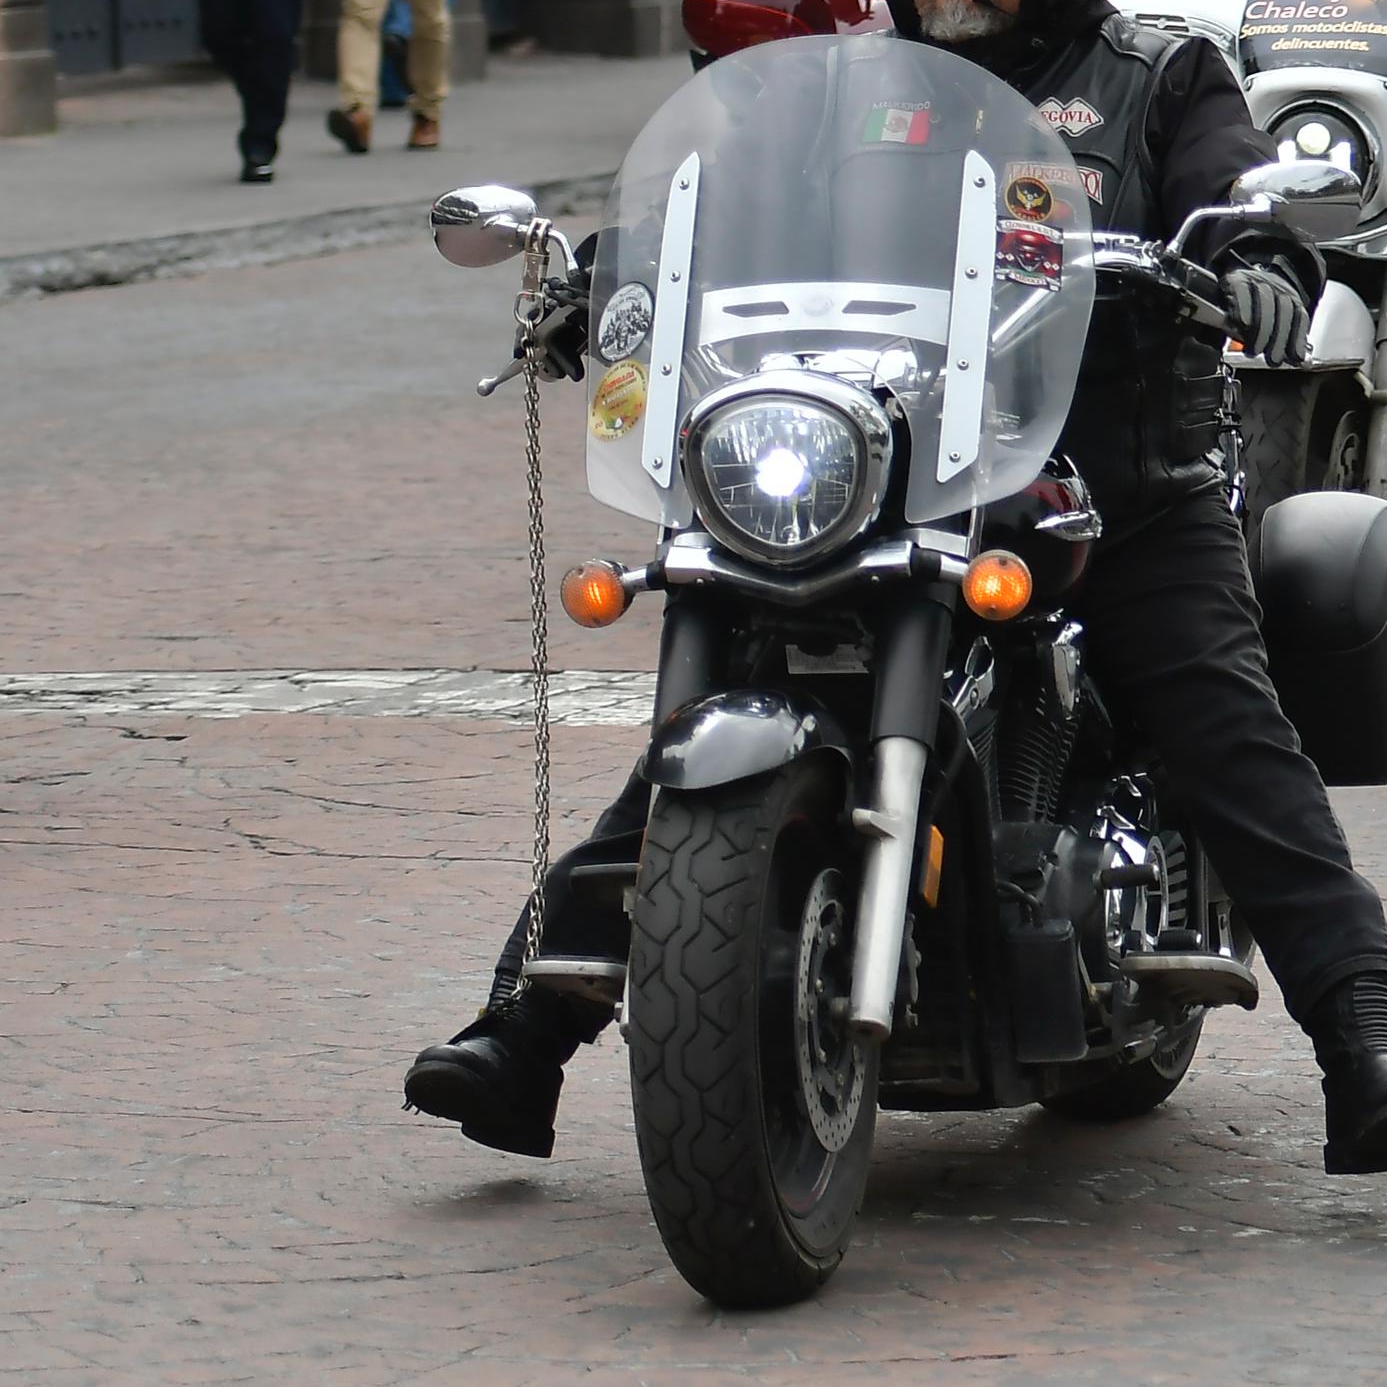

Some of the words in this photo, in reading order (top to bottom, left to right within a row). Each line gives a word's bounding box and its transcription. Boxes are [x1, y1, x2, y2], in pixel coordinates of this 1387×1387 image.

[1245, 1, 1349, 19] Chaleco
[1240, 22, 1288, 39] Somos
[1036, 109, 1095, 124] EGOVIA
